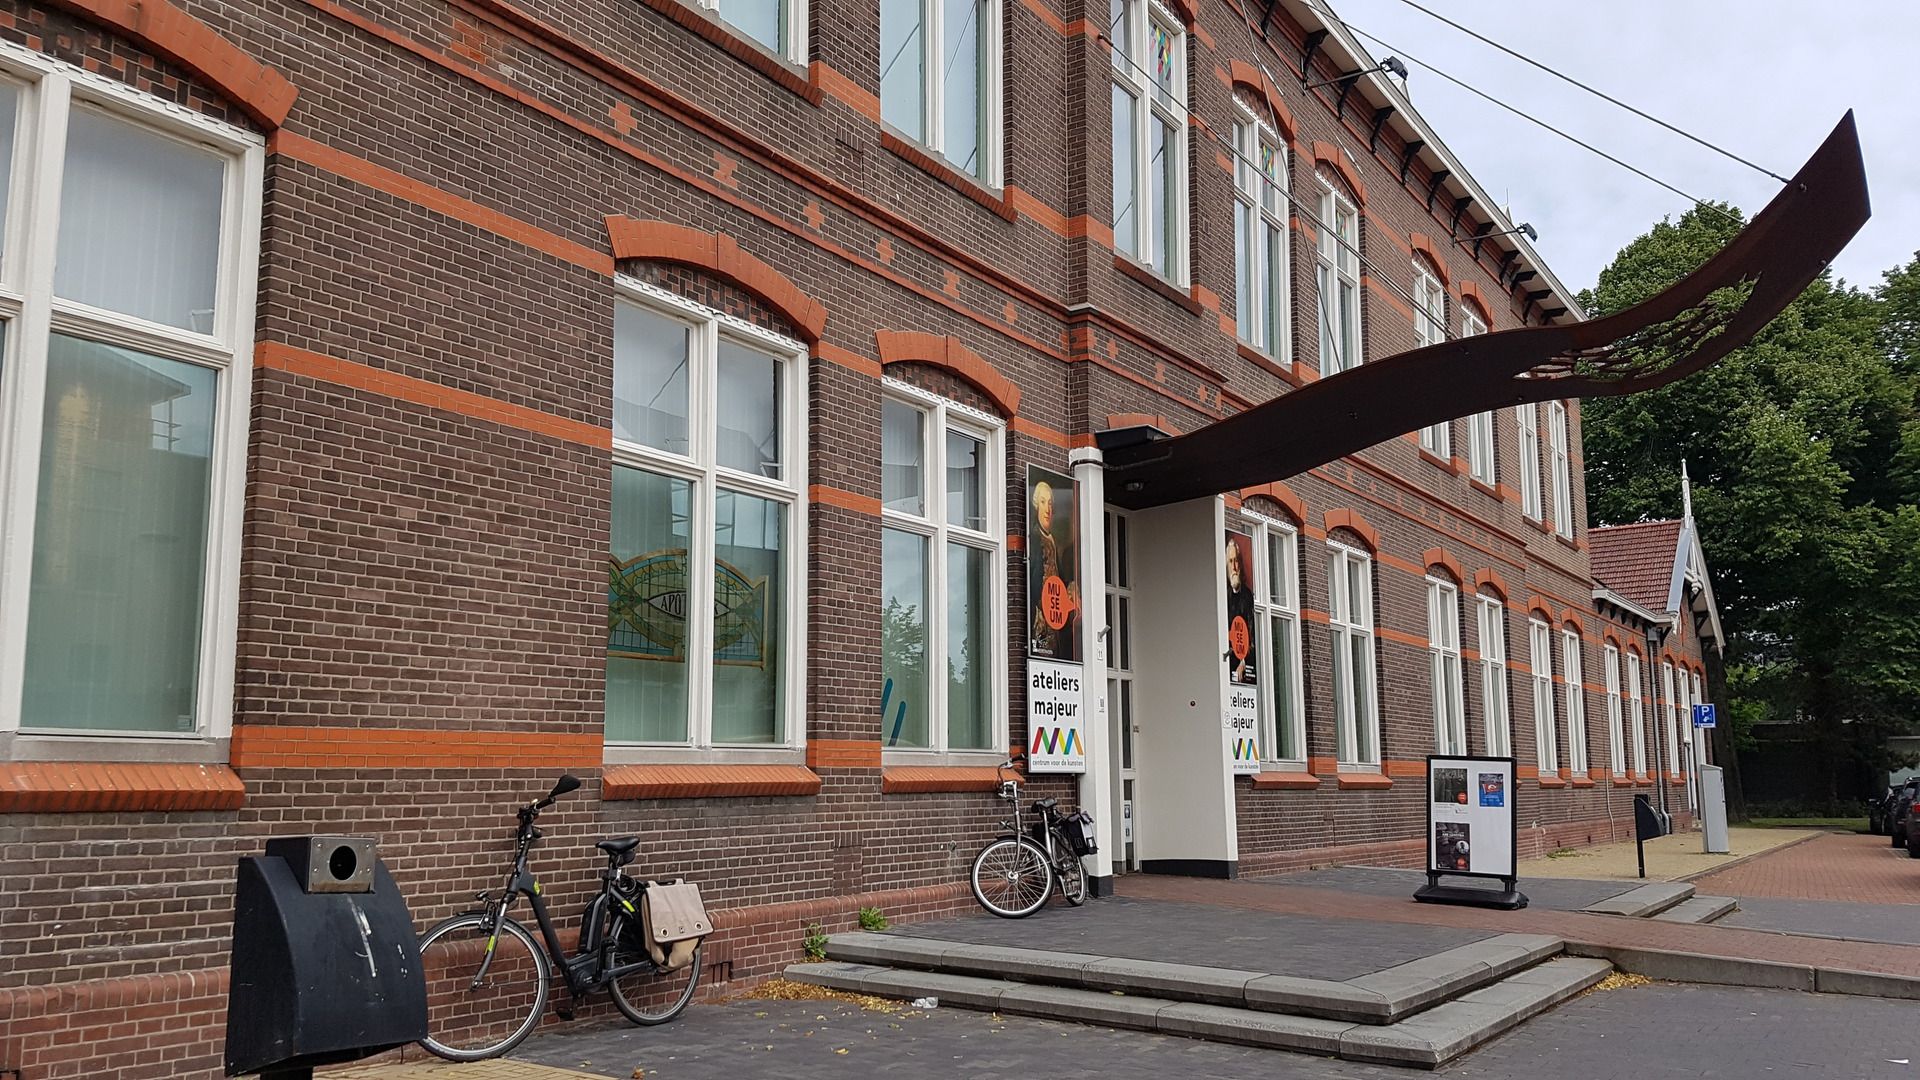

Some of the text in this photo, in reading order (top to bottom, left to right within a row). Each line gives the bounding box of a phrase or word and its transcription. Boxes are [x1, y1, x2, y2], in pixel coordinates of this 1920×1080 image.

[1048, 583, 1060, 595] MU
[1051, 598, 1060, 610] SE
[1049, 611, 1063, 624] UM
[1236, 633, 1243, 643] SE
[1032, 670, 1079, 692] ateliers
[1230, 691, 1255, 709] eliers
[1034, 697, 1078, 721] majeur
[1701, 706, 1709, 716] P
[1230, 713, 1254, 733] ajeur
